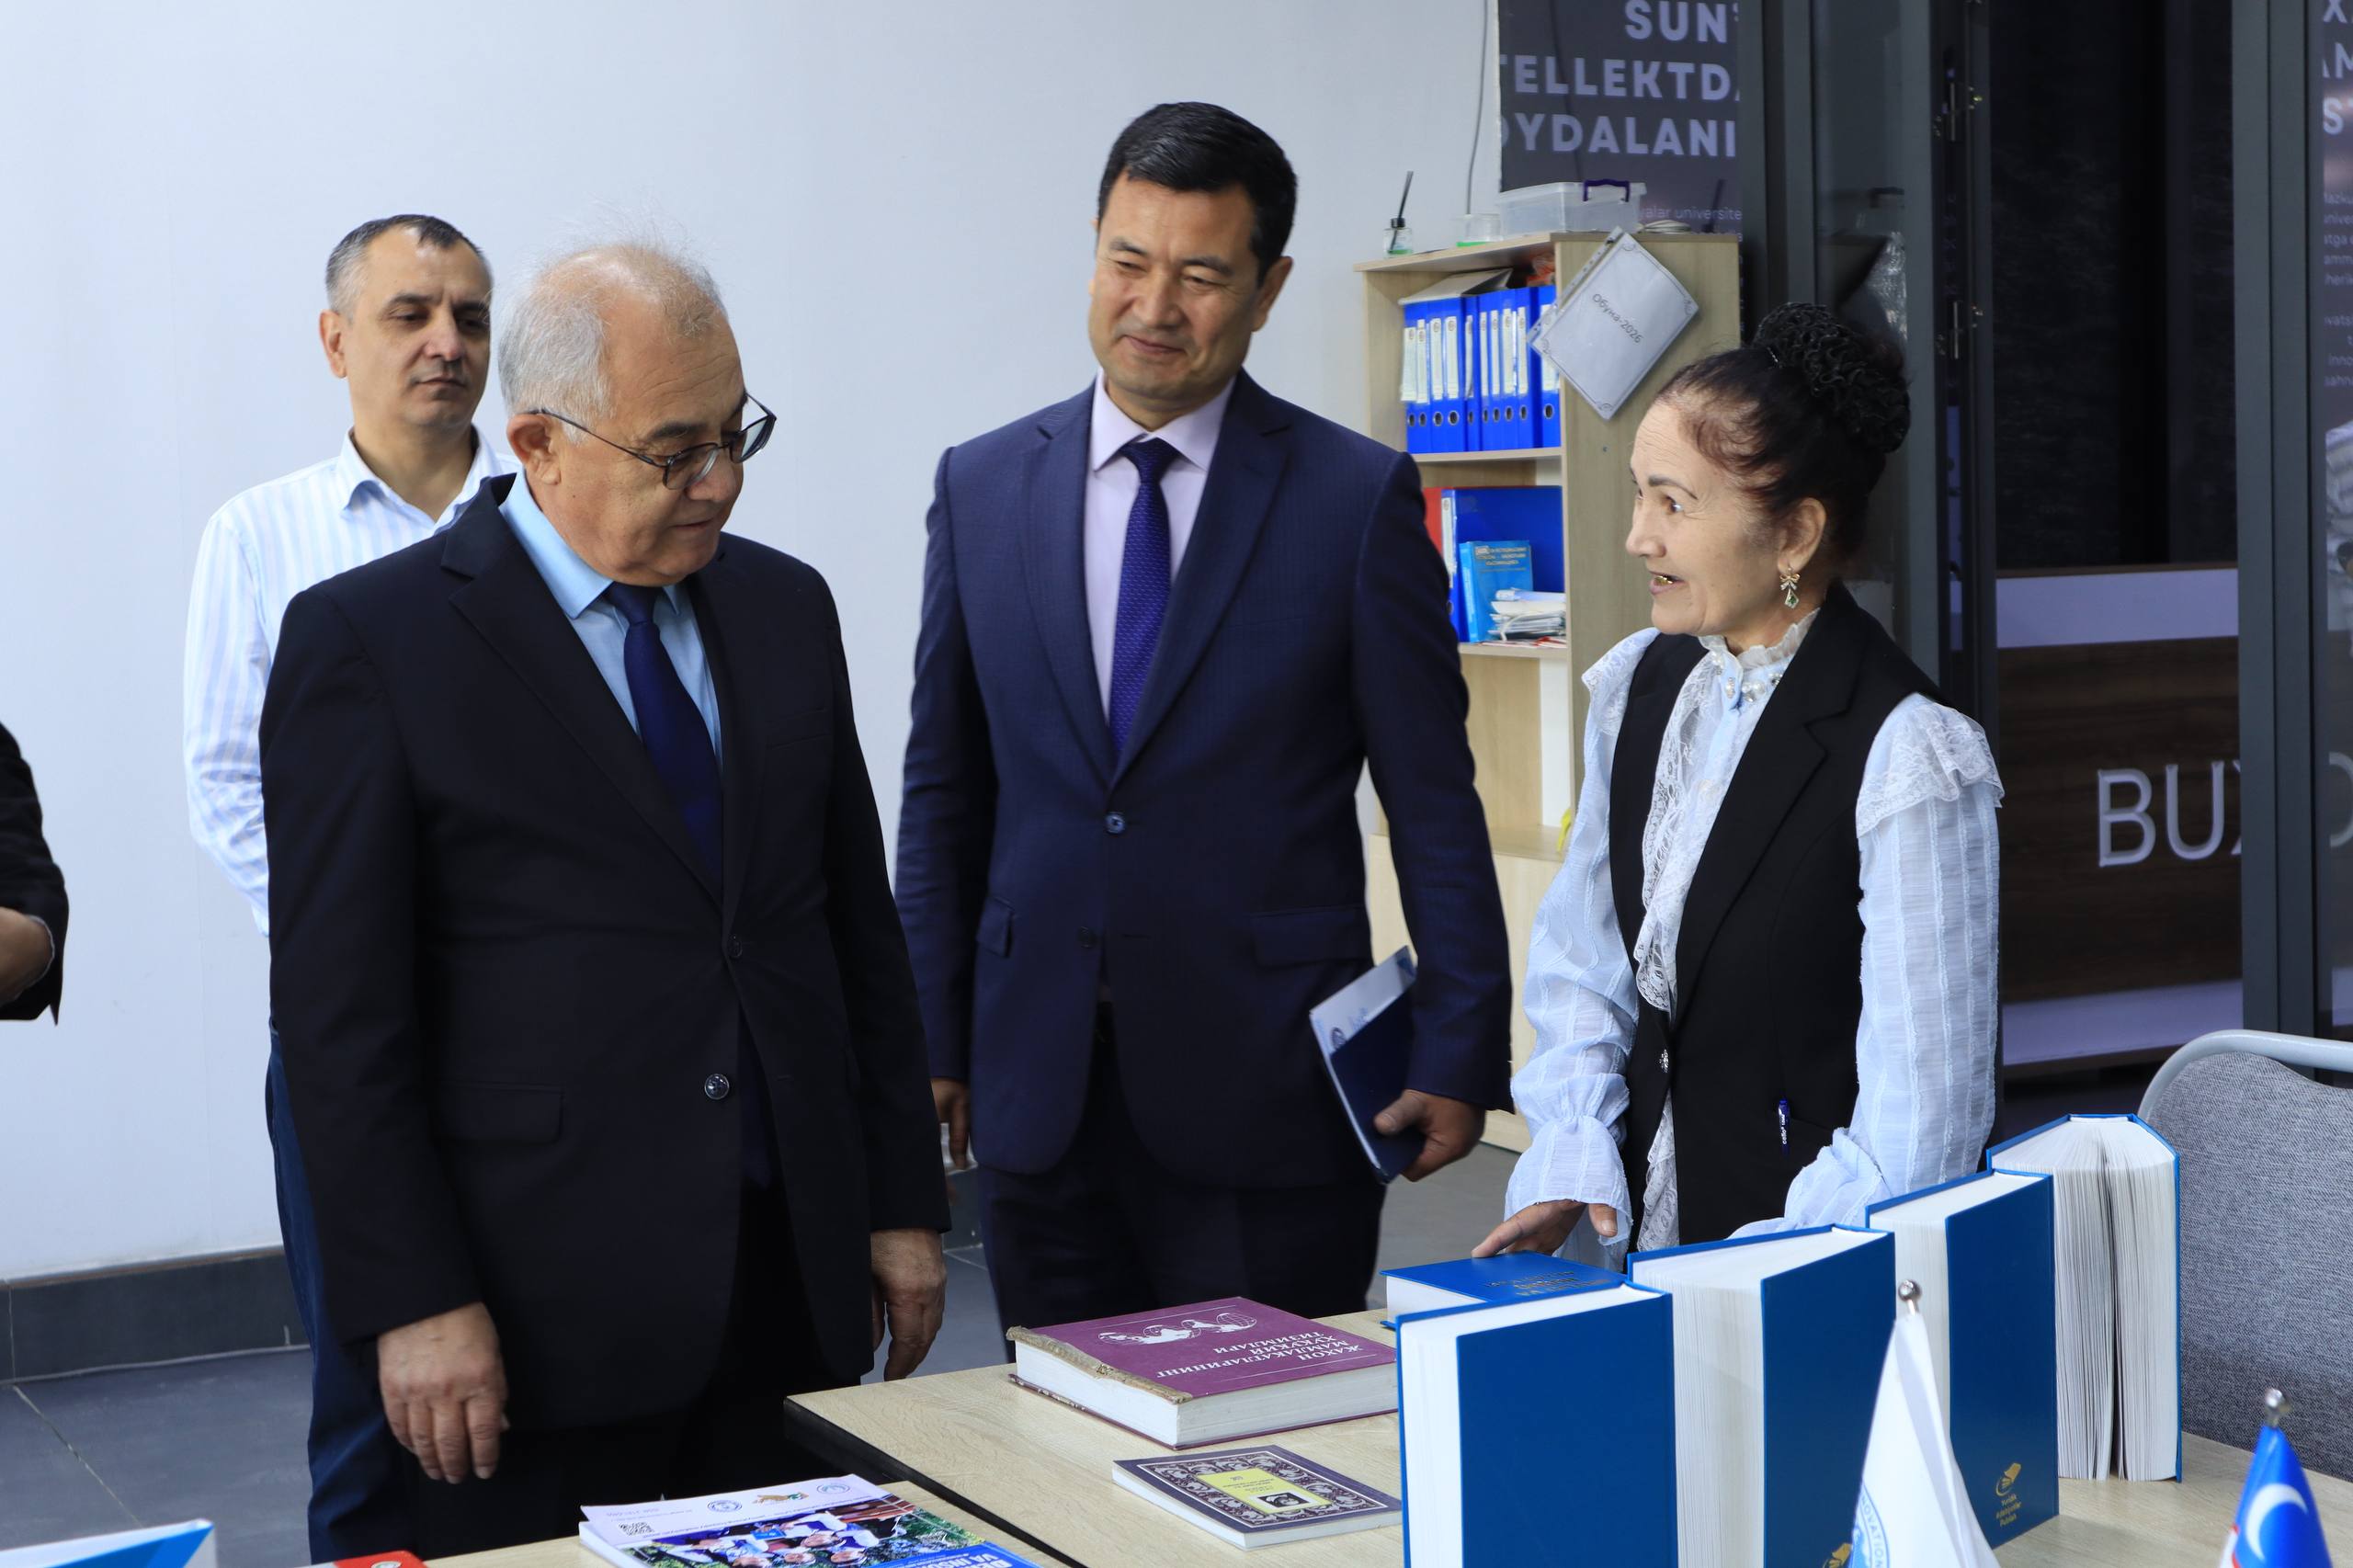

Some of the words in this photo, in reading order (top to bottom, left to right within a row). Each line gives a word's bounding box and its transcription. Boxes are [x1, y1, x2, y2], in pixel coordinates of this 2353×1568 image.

[1500, 54, 1740, 101] ELLEKTD
[1501, 112, 1735, 158] YDALANI
[1156, 1340, 1349, 1378] МАМЛАКАТЛАРИНИНГ
[1213, 1331, 1325, 1354] ТИЗИМЛАРИ
